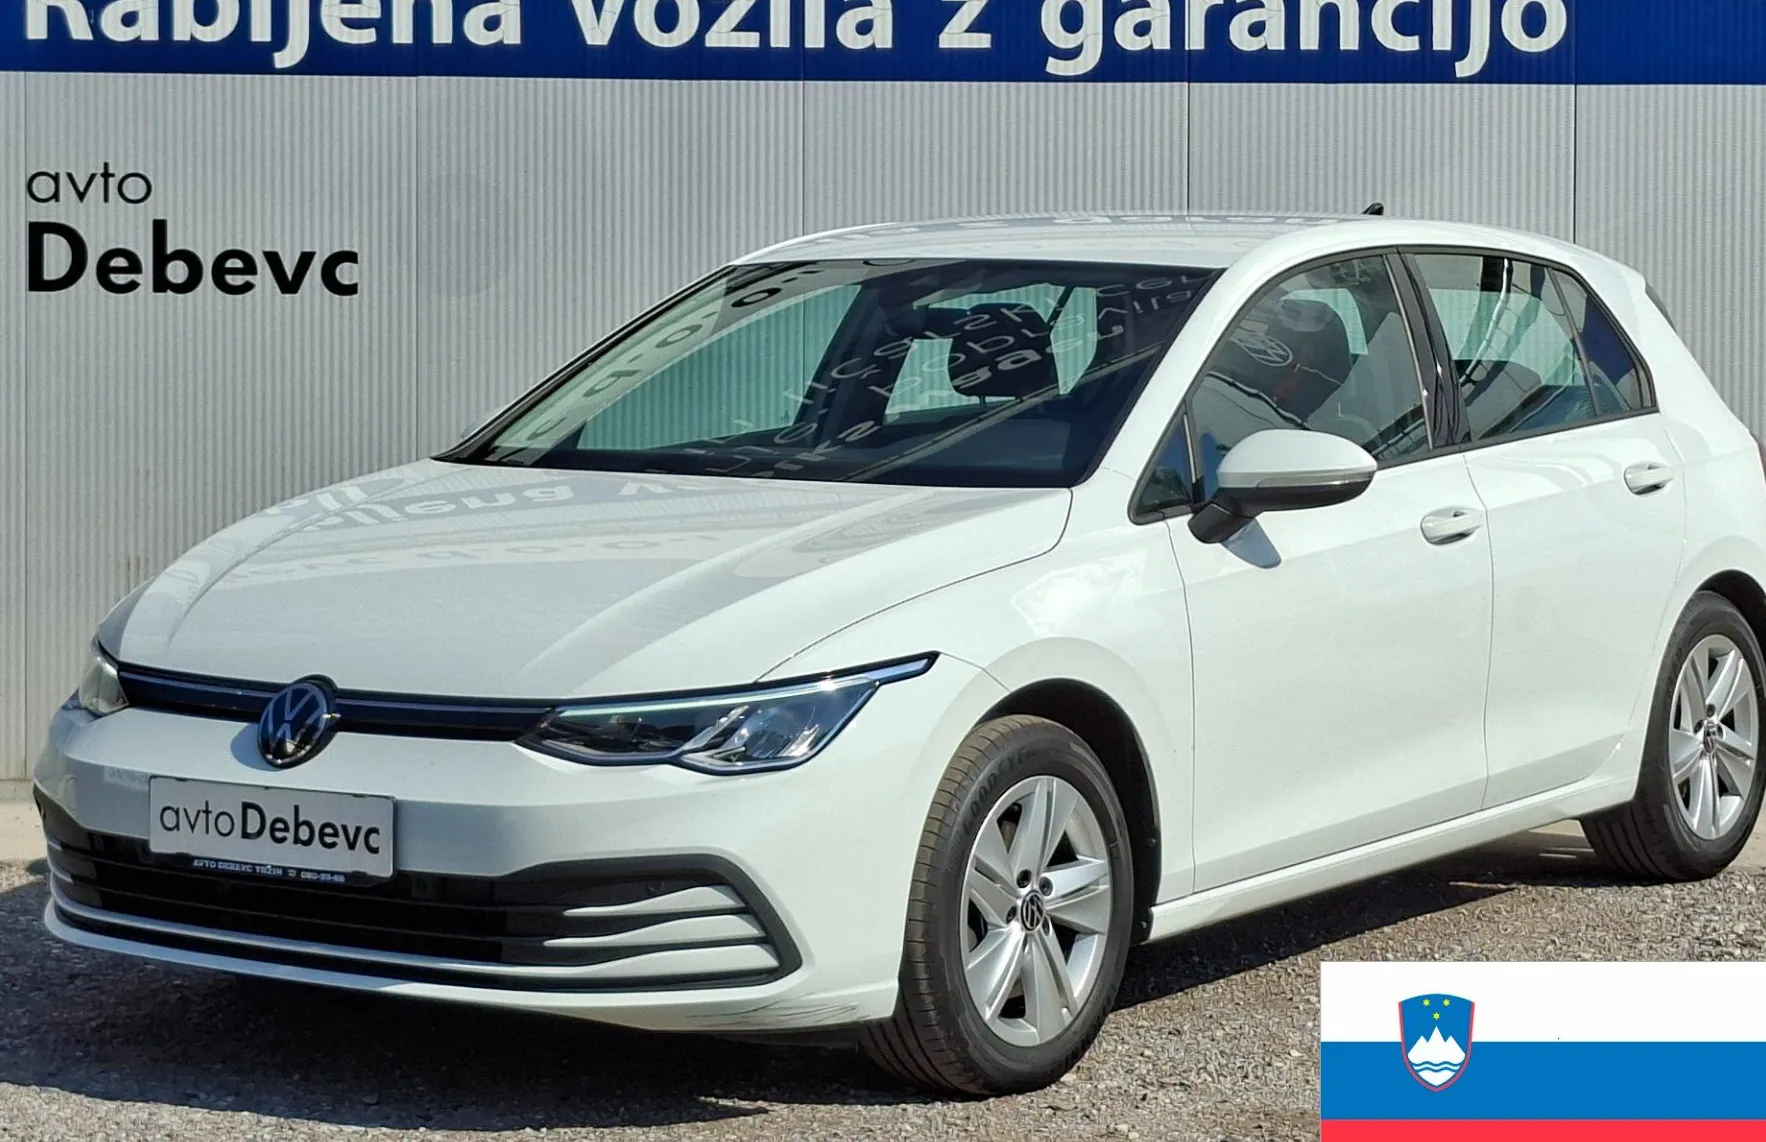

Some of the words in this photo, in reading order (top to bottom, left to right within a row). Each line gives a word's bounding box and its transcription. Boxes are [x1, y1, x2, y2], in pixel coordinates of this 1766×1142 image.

[939, 0, 992, 49] z
[1041, 0, 1568, 78] garancijo
[27, 162, 153, 204] avto
[28, 219, 359, 297] Debevc
